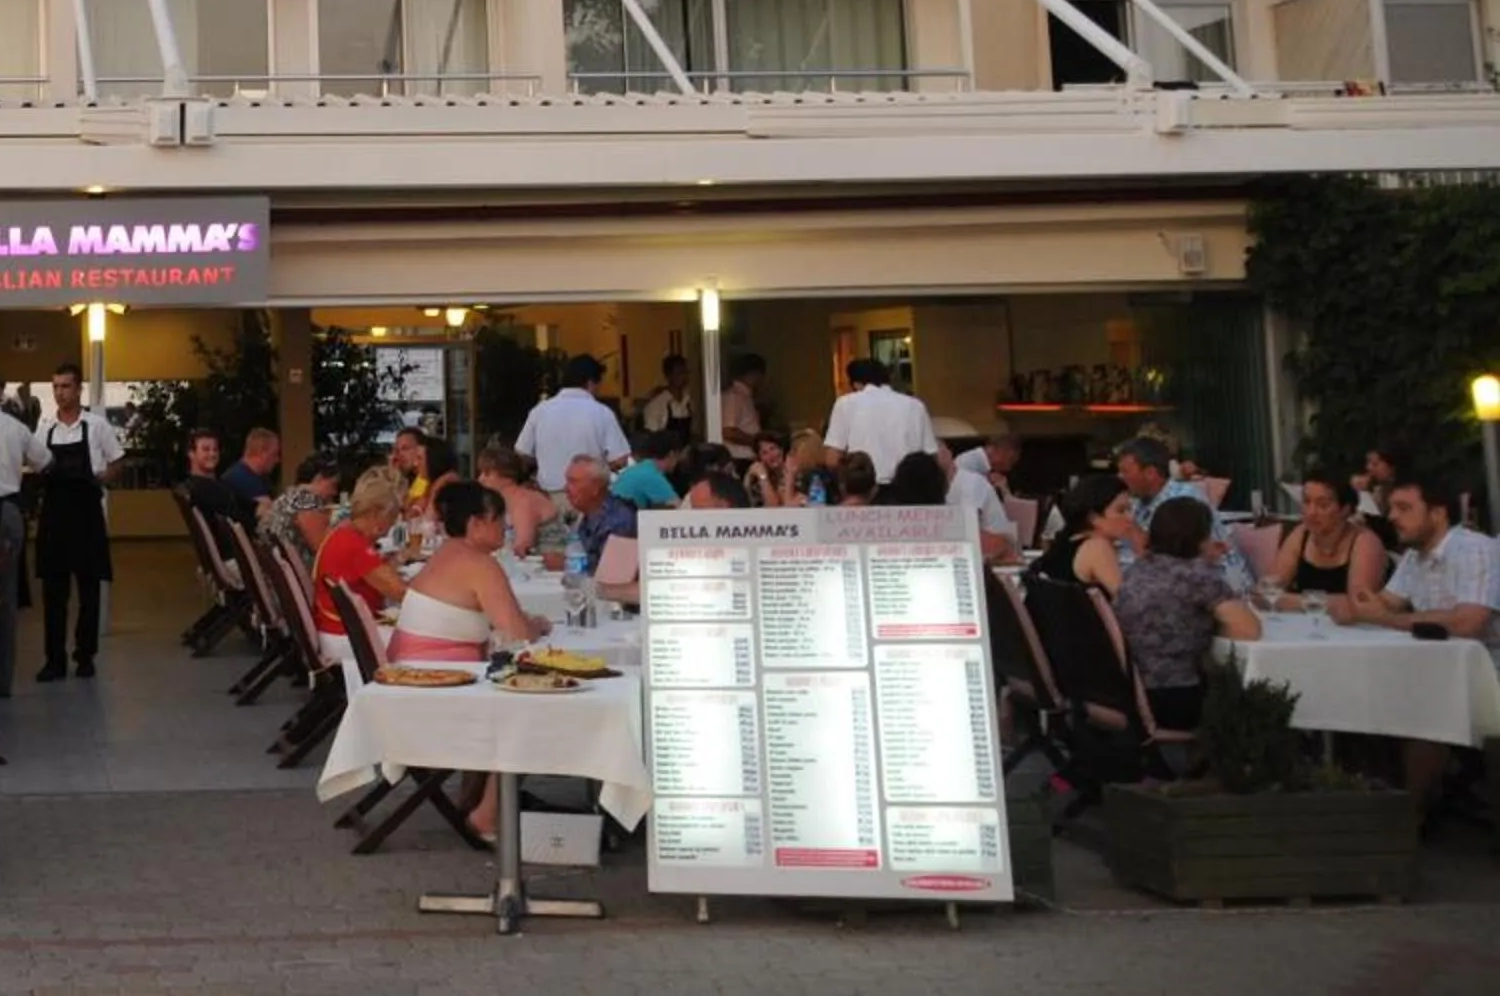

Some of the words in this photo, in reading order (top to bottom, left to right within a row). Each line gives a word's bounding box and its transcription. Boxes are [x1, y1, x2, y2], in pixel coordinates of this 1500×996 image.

[68, 222, 259, 255] MAMMA'S
[71, 265, 236, 288] RESTAURANT
[659, 526, 710, 539] BELLA
[715, 524, 800, 538] MAMMA'S
